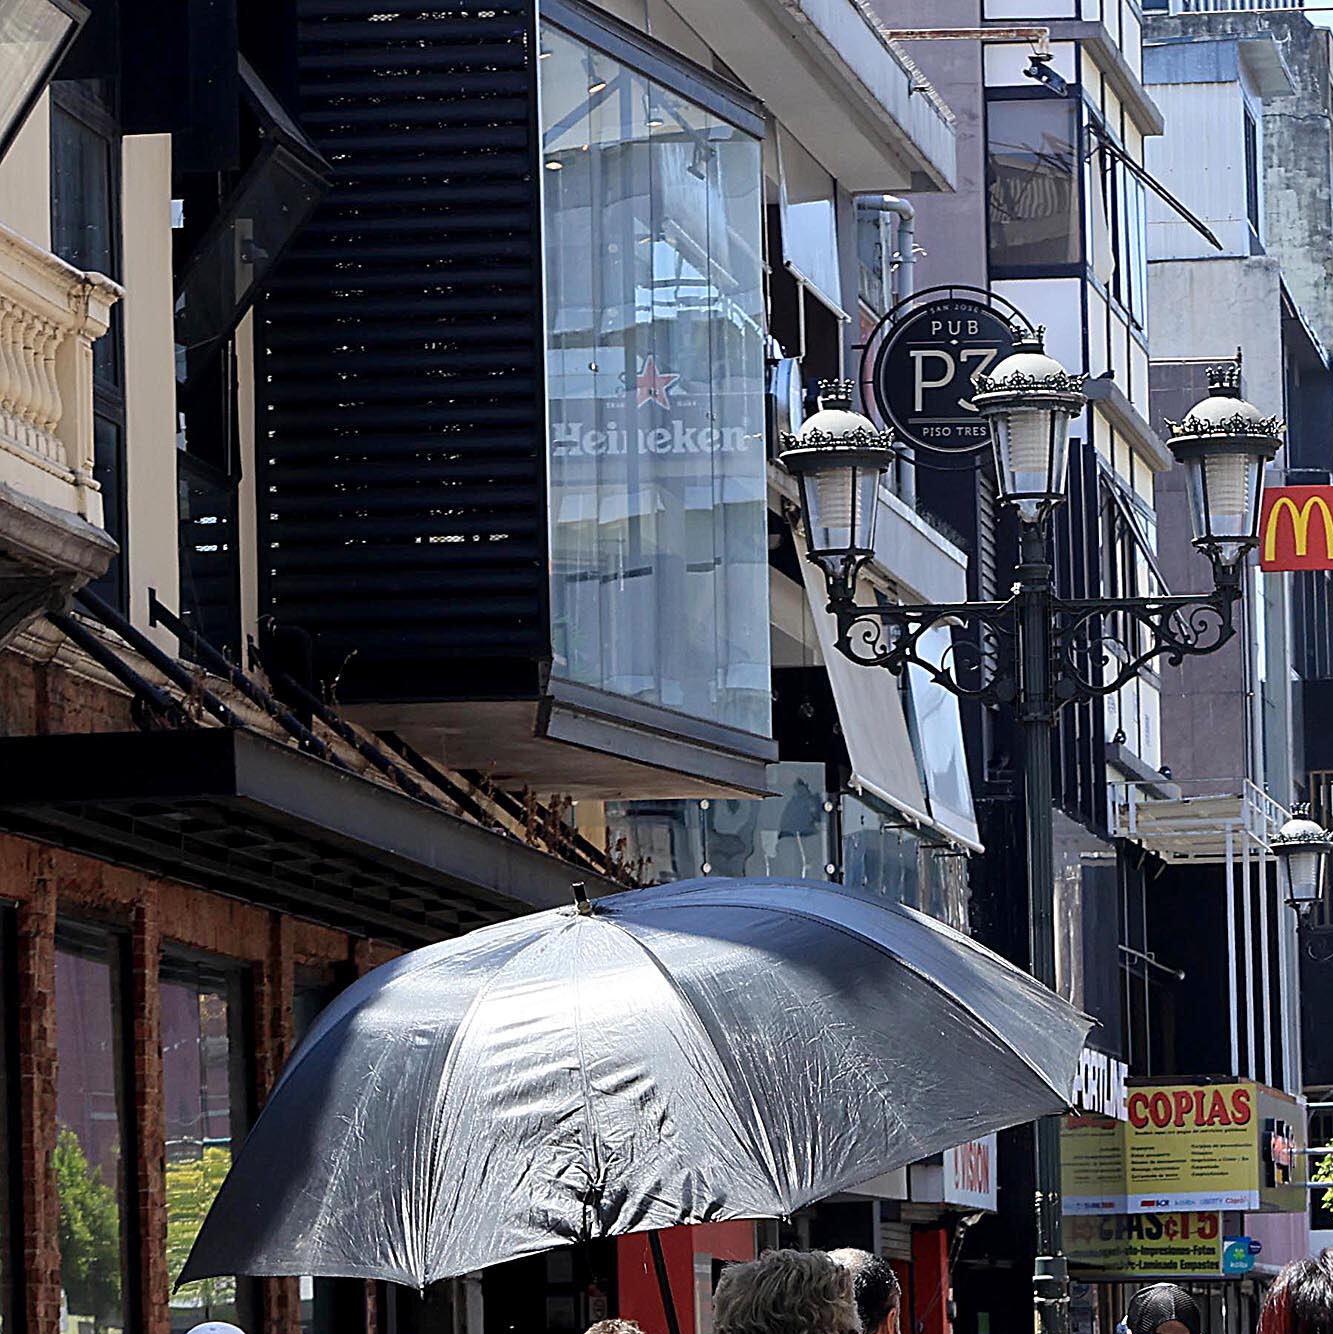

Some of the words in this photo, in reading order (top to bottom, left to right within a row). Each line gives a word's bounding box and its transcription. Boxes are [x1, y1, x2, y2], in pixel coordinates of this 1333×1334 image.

[931, 320, 979, 336] PUB
[551, 420, 750, 457] Heineken
[923, 427, 952, 437] PISO
[956, 426, 987, 437] TRES
[1128, 1088, 1251, 1129] COPIAS
